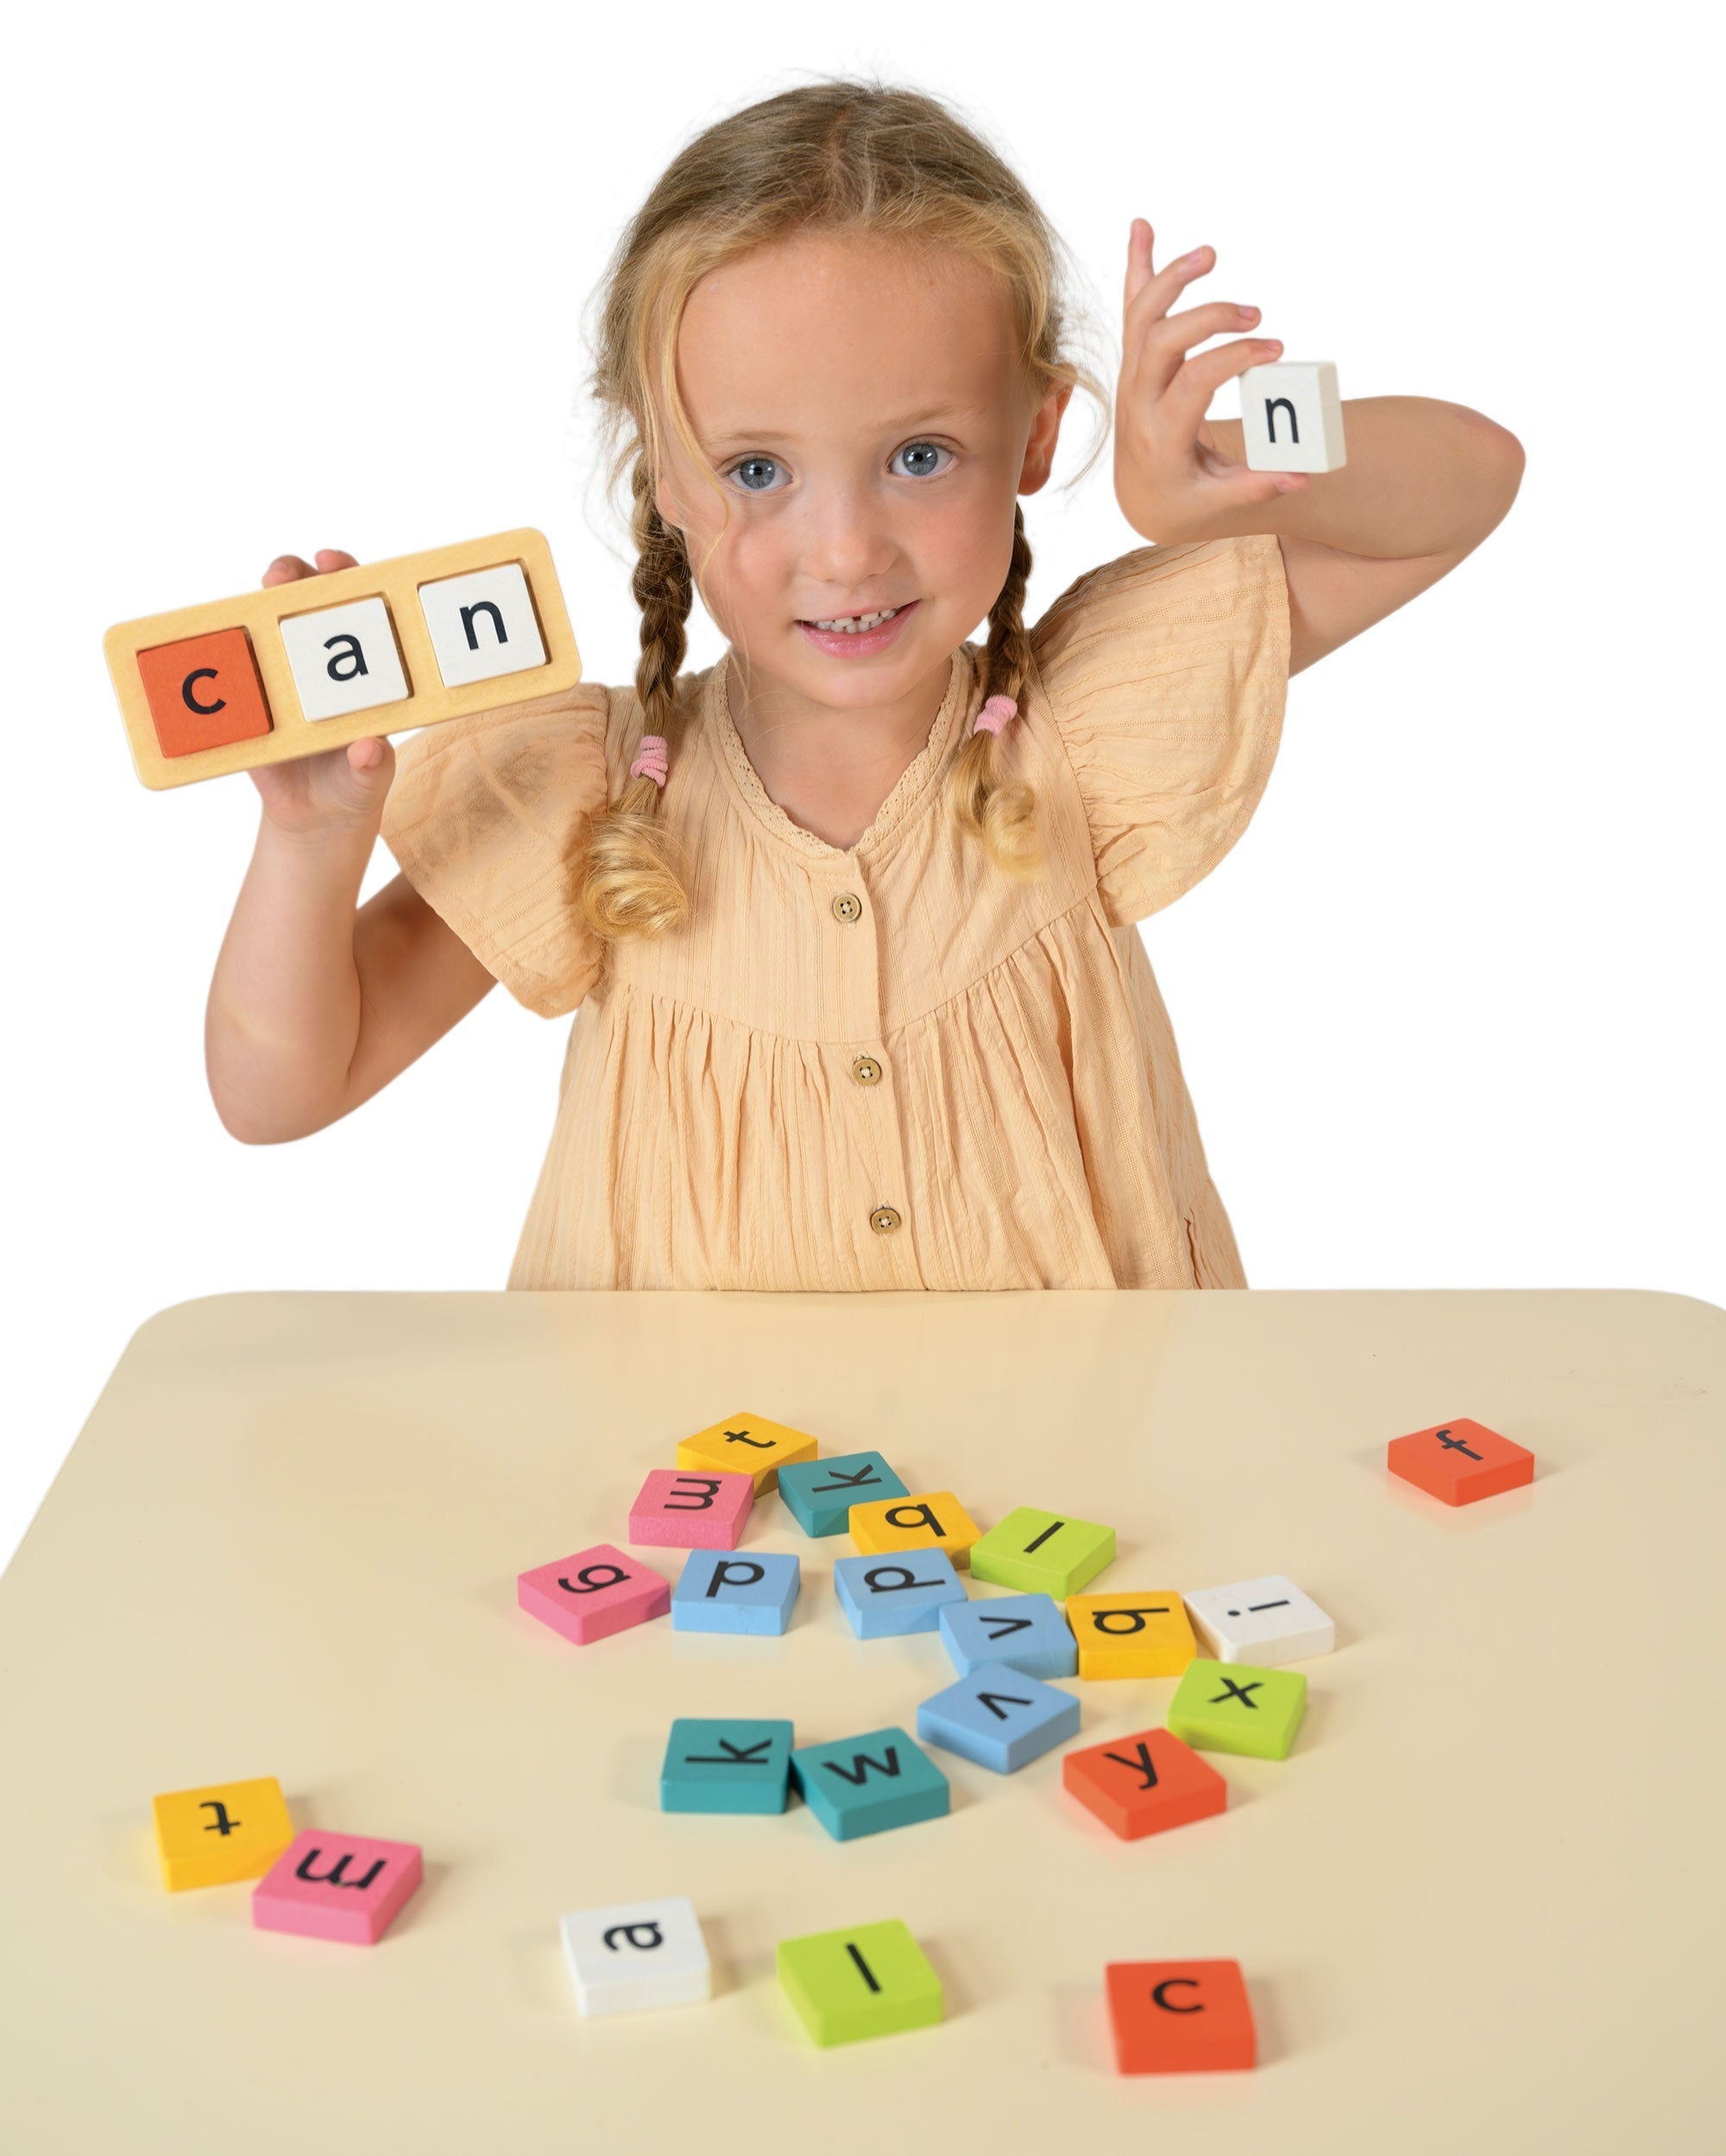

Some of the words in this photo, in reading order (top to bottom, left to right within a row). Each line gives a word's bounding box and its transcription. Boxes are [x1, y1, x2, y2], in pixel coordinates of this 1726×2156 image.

[1265, 398, 1299, 444] n
[182, 601, 508, 716] can
[723, 1430, 777, 1448] t
[1436, 1429, 1483, 1460] f
[664, 1478, 721, 1510] m
[811, 1463, 883, 1494] k
[557, 1565, 631, 1593] g
[1228, 1600, 1289, 1617] i
[980, 1617, 1033, 1640] v
[977, 1693, 1032, 1720] v
[1211, 1678, 1262, 1708] x
[683, 1737, 773, 1766] k
[822, 1745, 902, 1787] w
[1106, 1743, 1158, 1789] y
[200, 1801, 240, 1836] t
[296, 1850, 386, 1889] m
[603, 1922, 663, 1951] a
[1152, 1980, 1202, 2013] c
